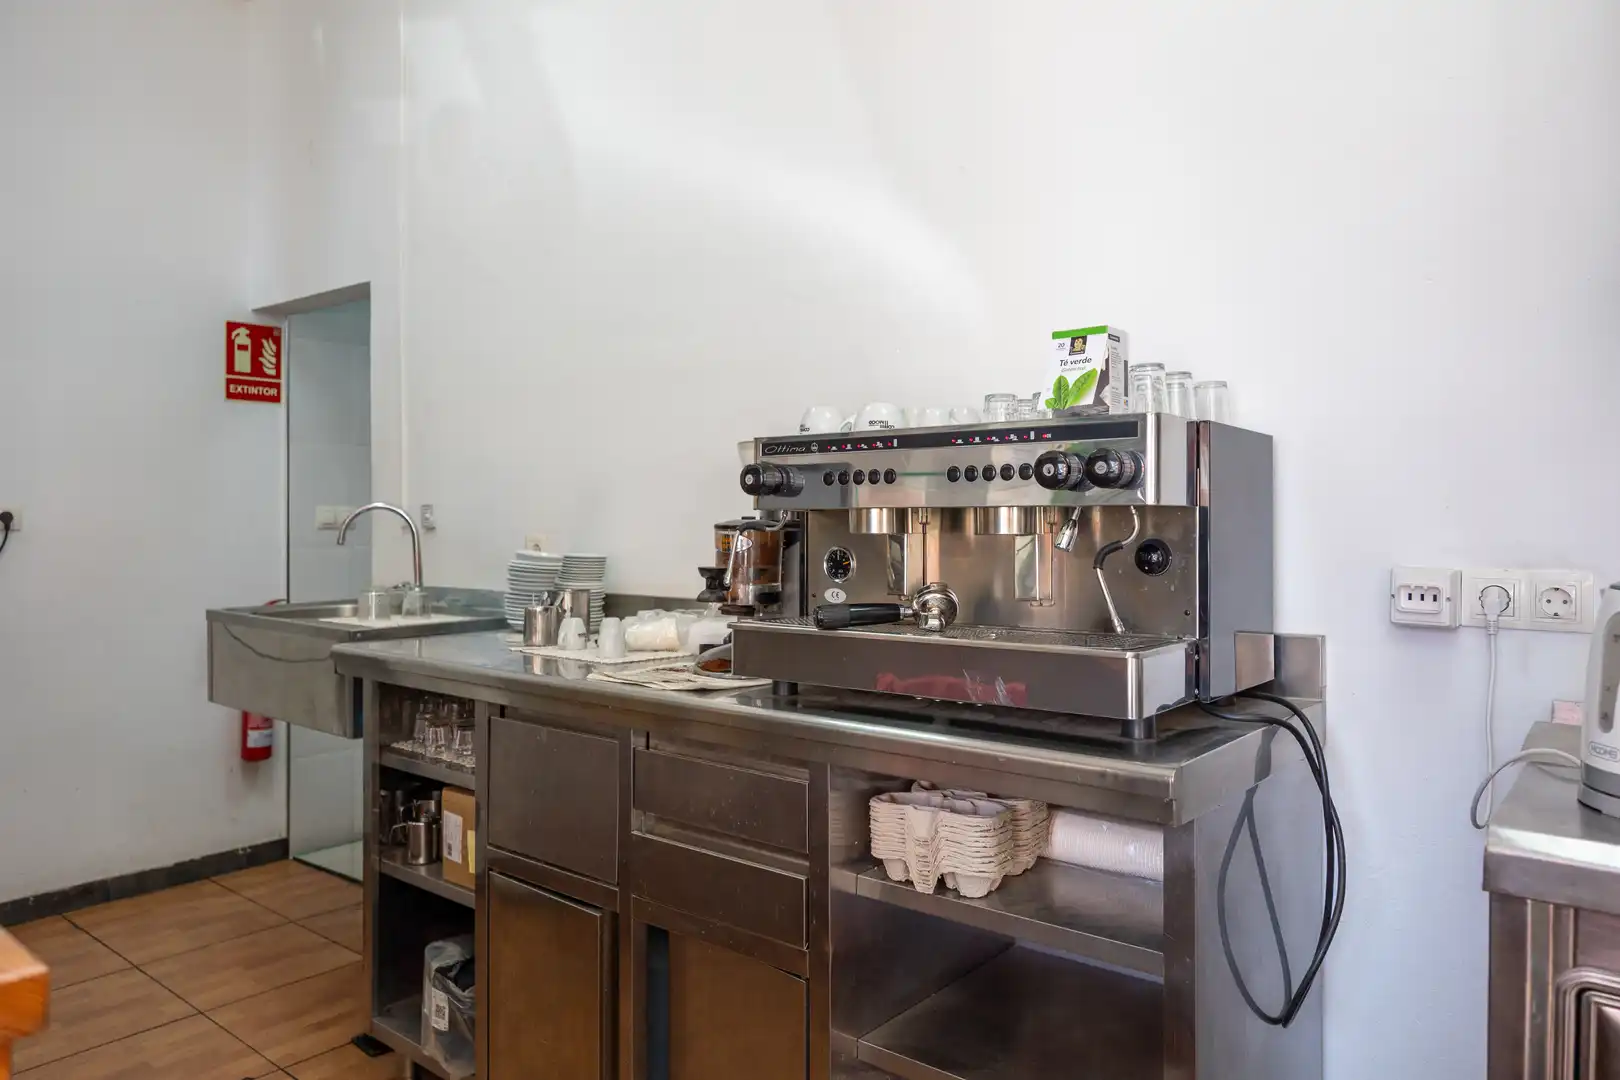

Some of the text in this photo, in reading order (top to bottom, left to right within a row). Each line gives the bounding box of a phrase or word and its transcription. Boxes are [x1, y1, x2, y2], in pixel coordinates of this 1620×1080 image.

[1060, 356, 1092, 367] Té verde
[229, 383, 278, 397] EXTINTOR
